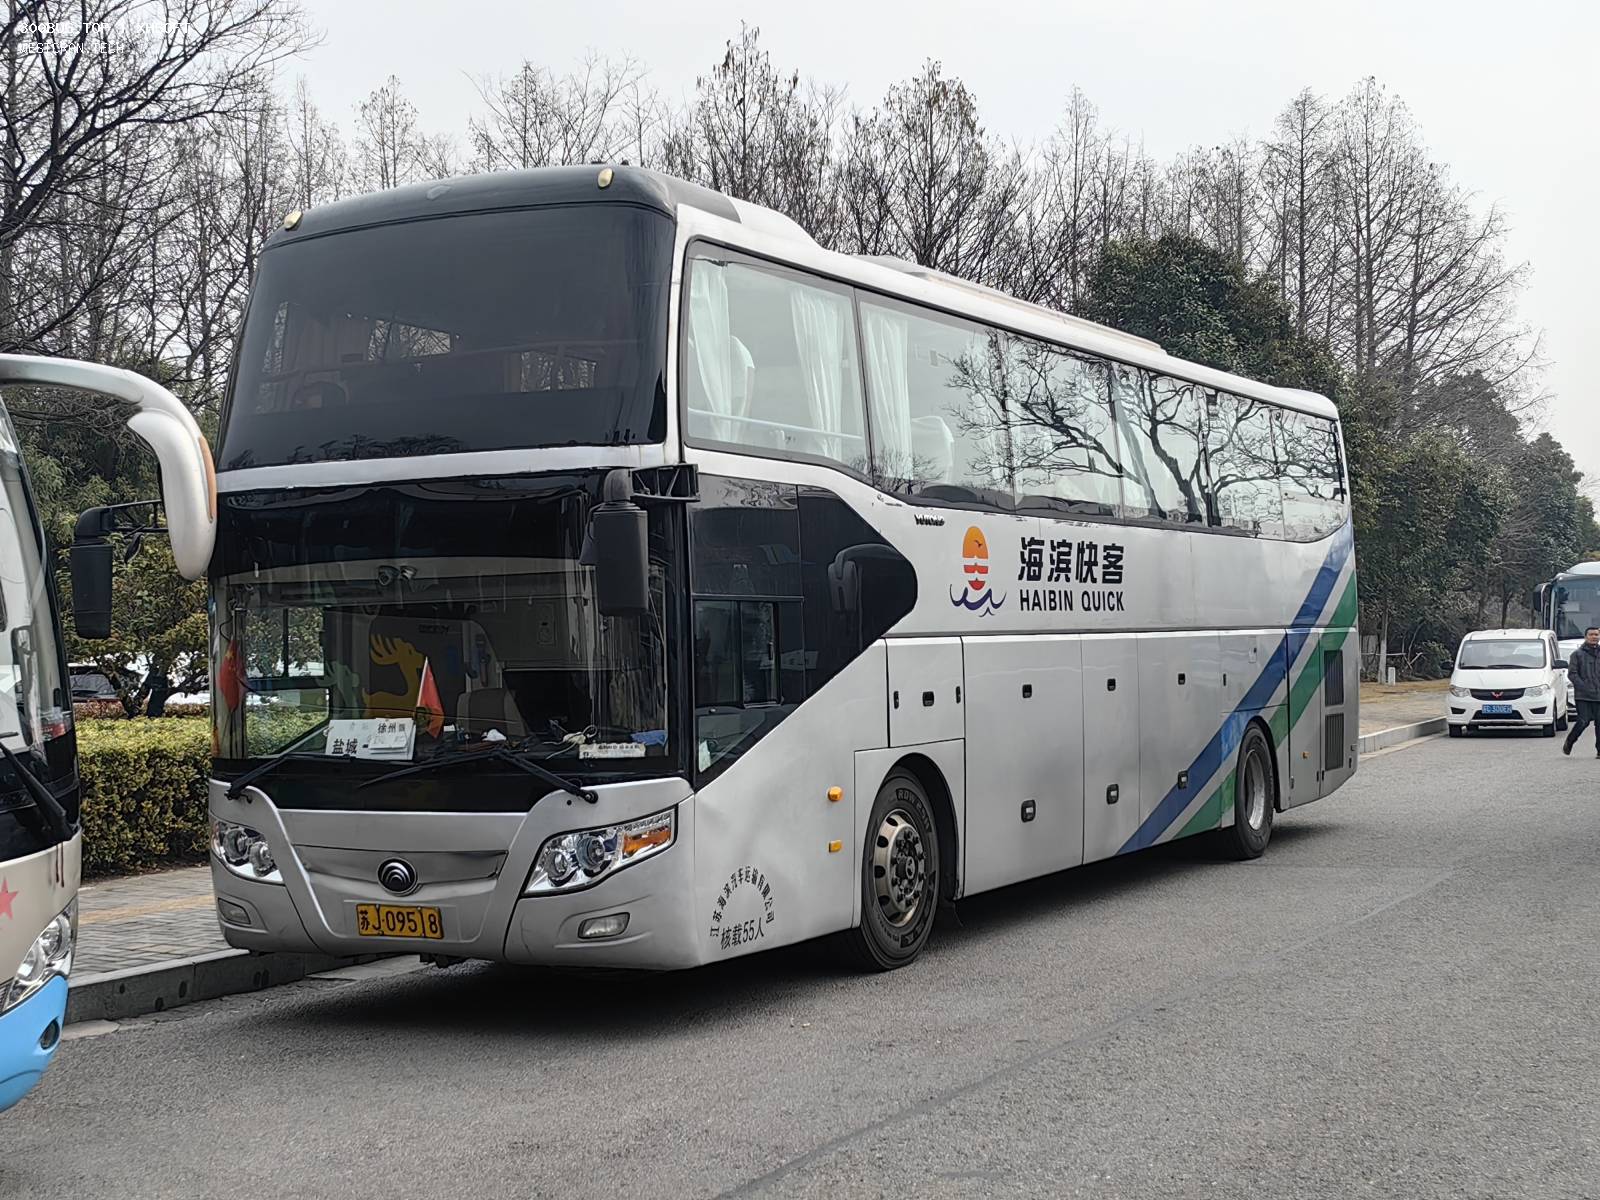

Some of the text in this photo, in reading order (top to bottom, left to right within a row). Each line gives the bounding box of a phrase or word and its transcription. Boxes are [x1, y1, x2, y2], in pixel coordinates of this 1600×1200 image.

[1018, 537, 1124, 584] 海滨快客
[1020, 589, 1125, 612] HAIBIN QUICK
[720, 916, 765, 950] 核载55人
